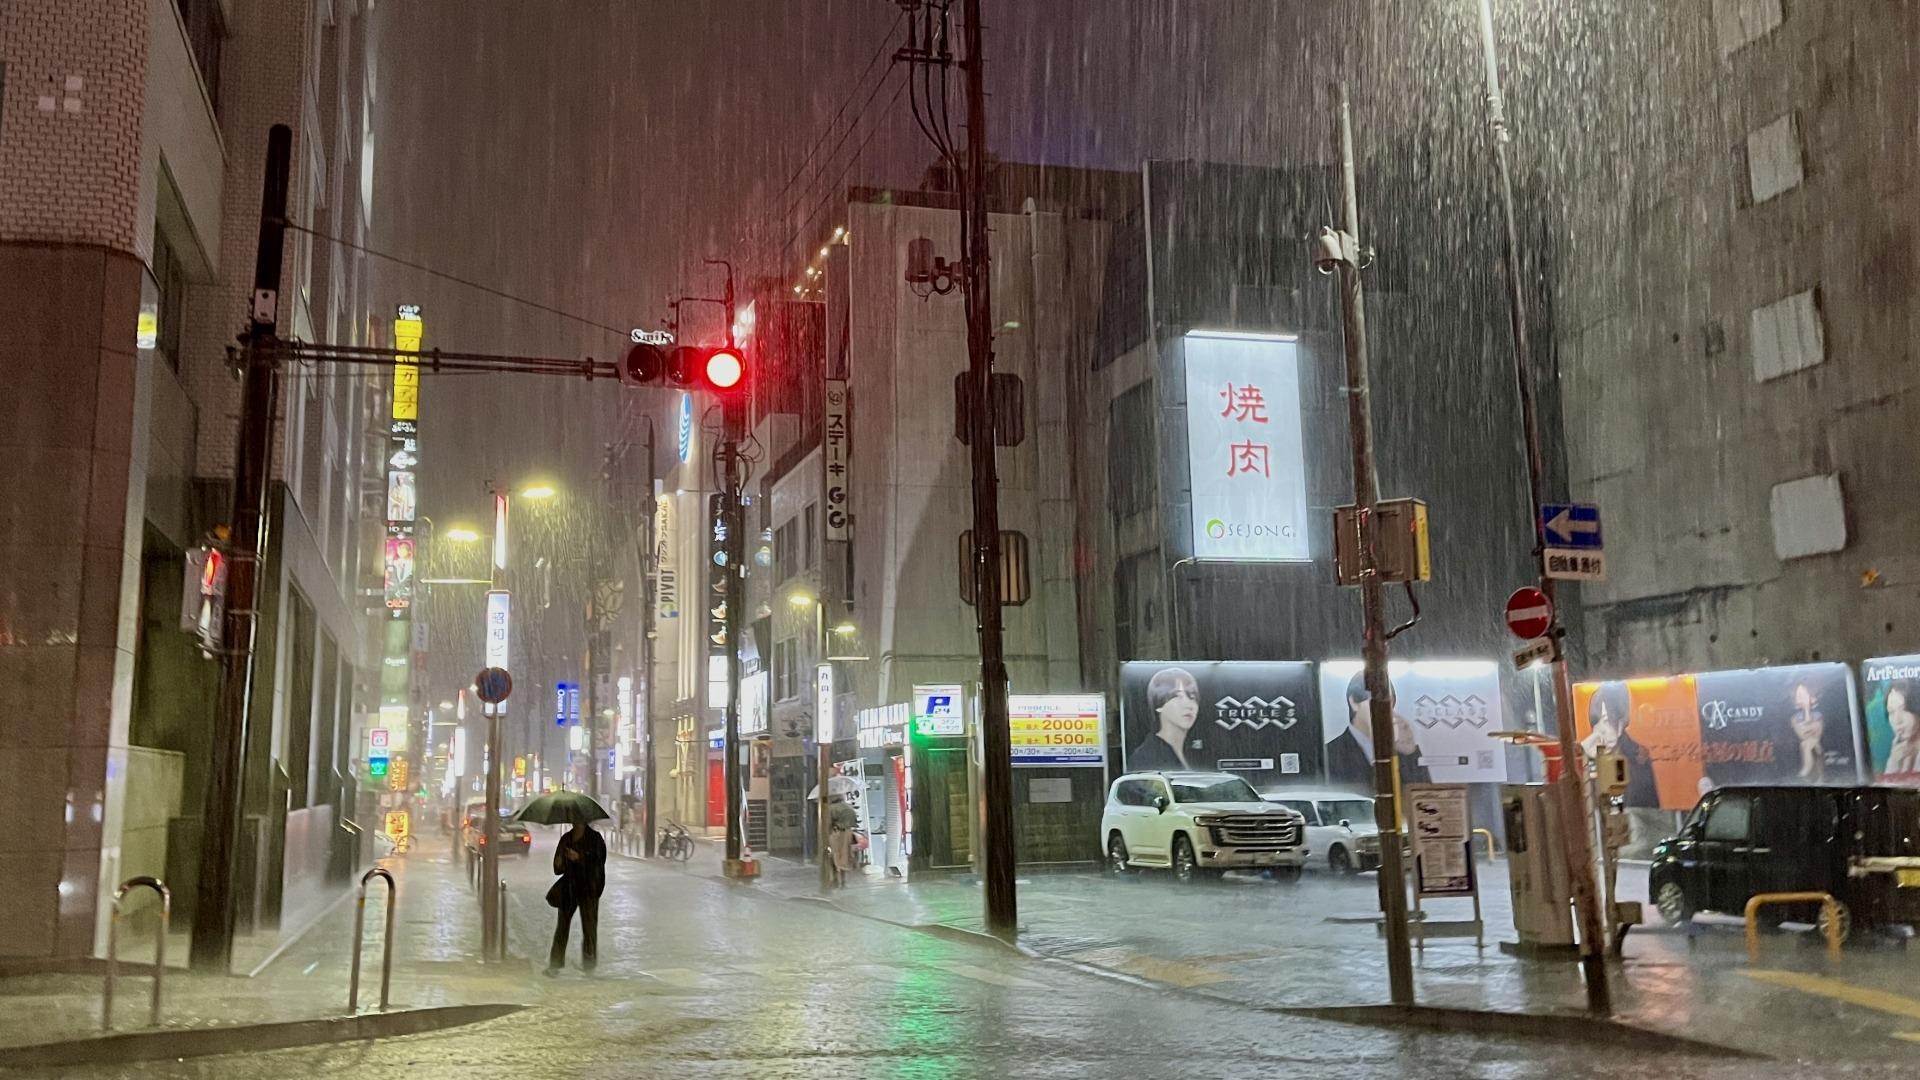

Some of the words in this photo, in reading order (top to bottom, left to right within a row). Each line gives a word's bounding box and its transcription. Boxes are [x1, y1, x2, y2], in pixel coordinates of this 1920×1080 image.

[1219, 381, 1271, 479] 焼肉
[1228, 523, 1291, 538] SEJONG
[660, 569, 675, 602] PIVOT
[1217, 708, 1280, 718] TRIPLE
[1727, 706, 1764, 718] CANDY
